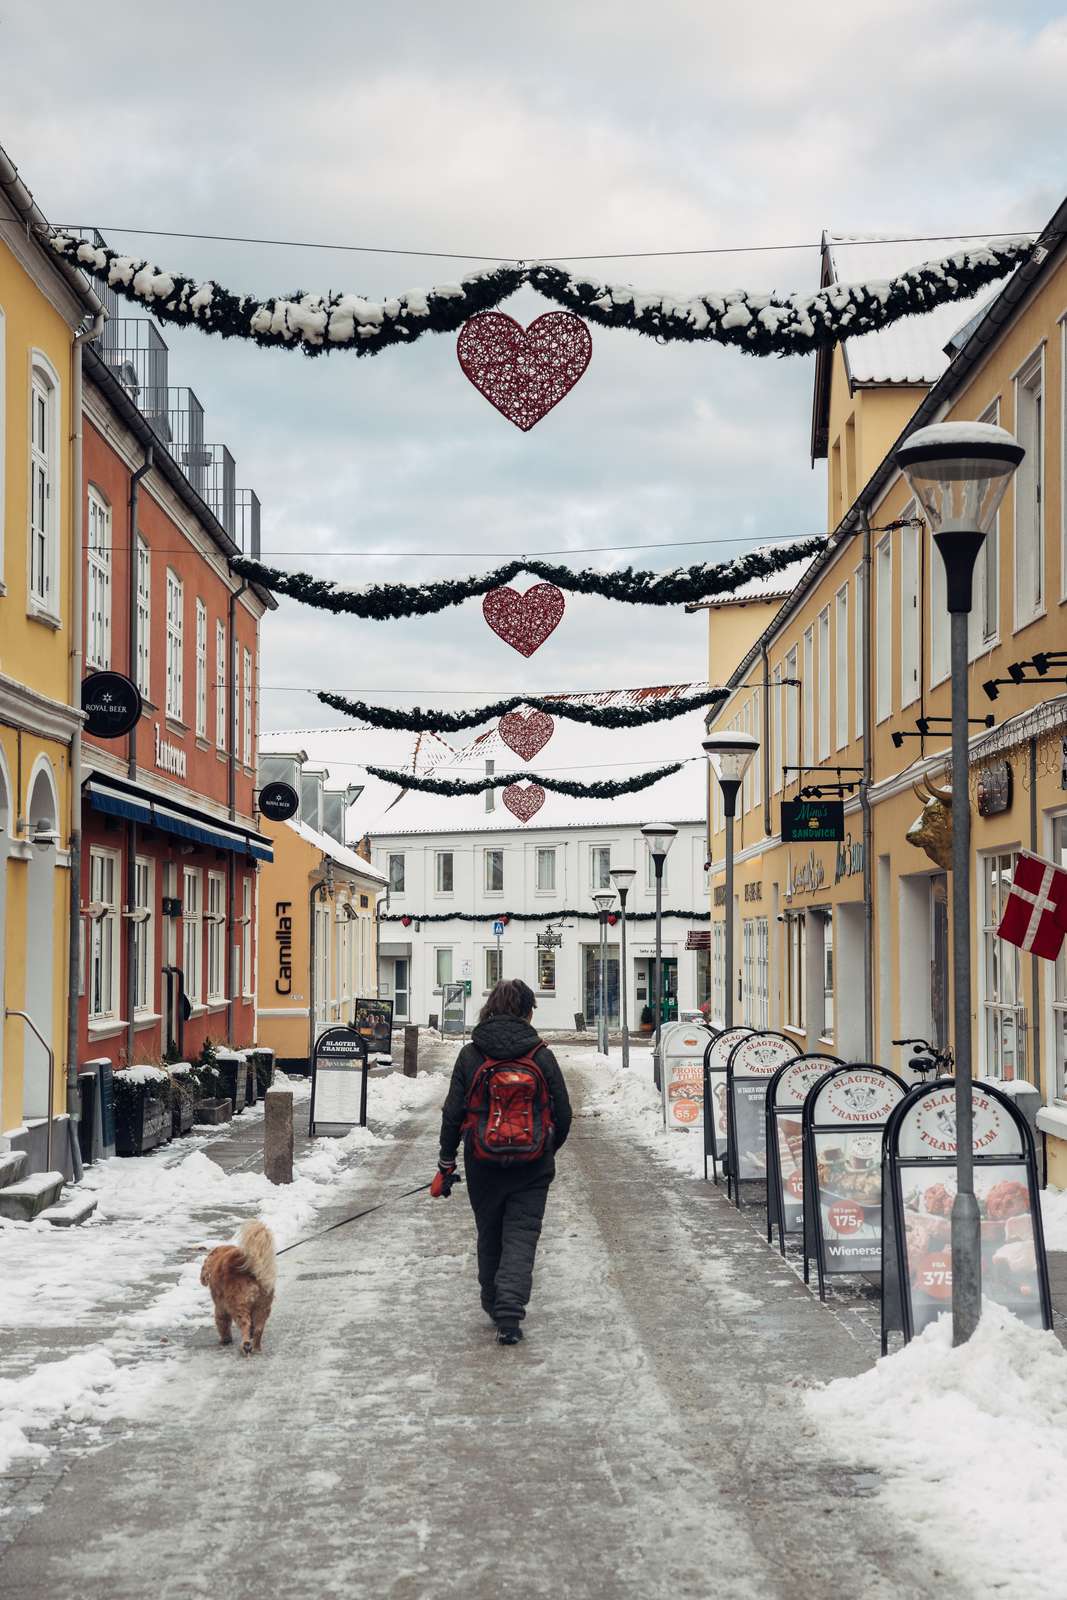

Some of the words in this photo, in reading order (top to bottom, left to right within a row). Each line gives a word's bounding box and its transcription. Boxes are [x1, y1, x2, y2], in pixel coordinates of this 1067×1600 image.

[86, 703, 107, 712] ROYAL
[109, 705, 127, 713] BEER
[792, 828, 835, 838] SANDWICH
[746, 1040, 785, 1052] SLAGTER
[792, 1063, 830, 1076] SLAGTE
[833, 1076, 886, 1090] SLAGTER
[922, 1094, 990, 1112] SLAGER
[831, 1104, 892, 1122] TRANHOLM
[920, 1129, 998, 1152] TRANOLM
